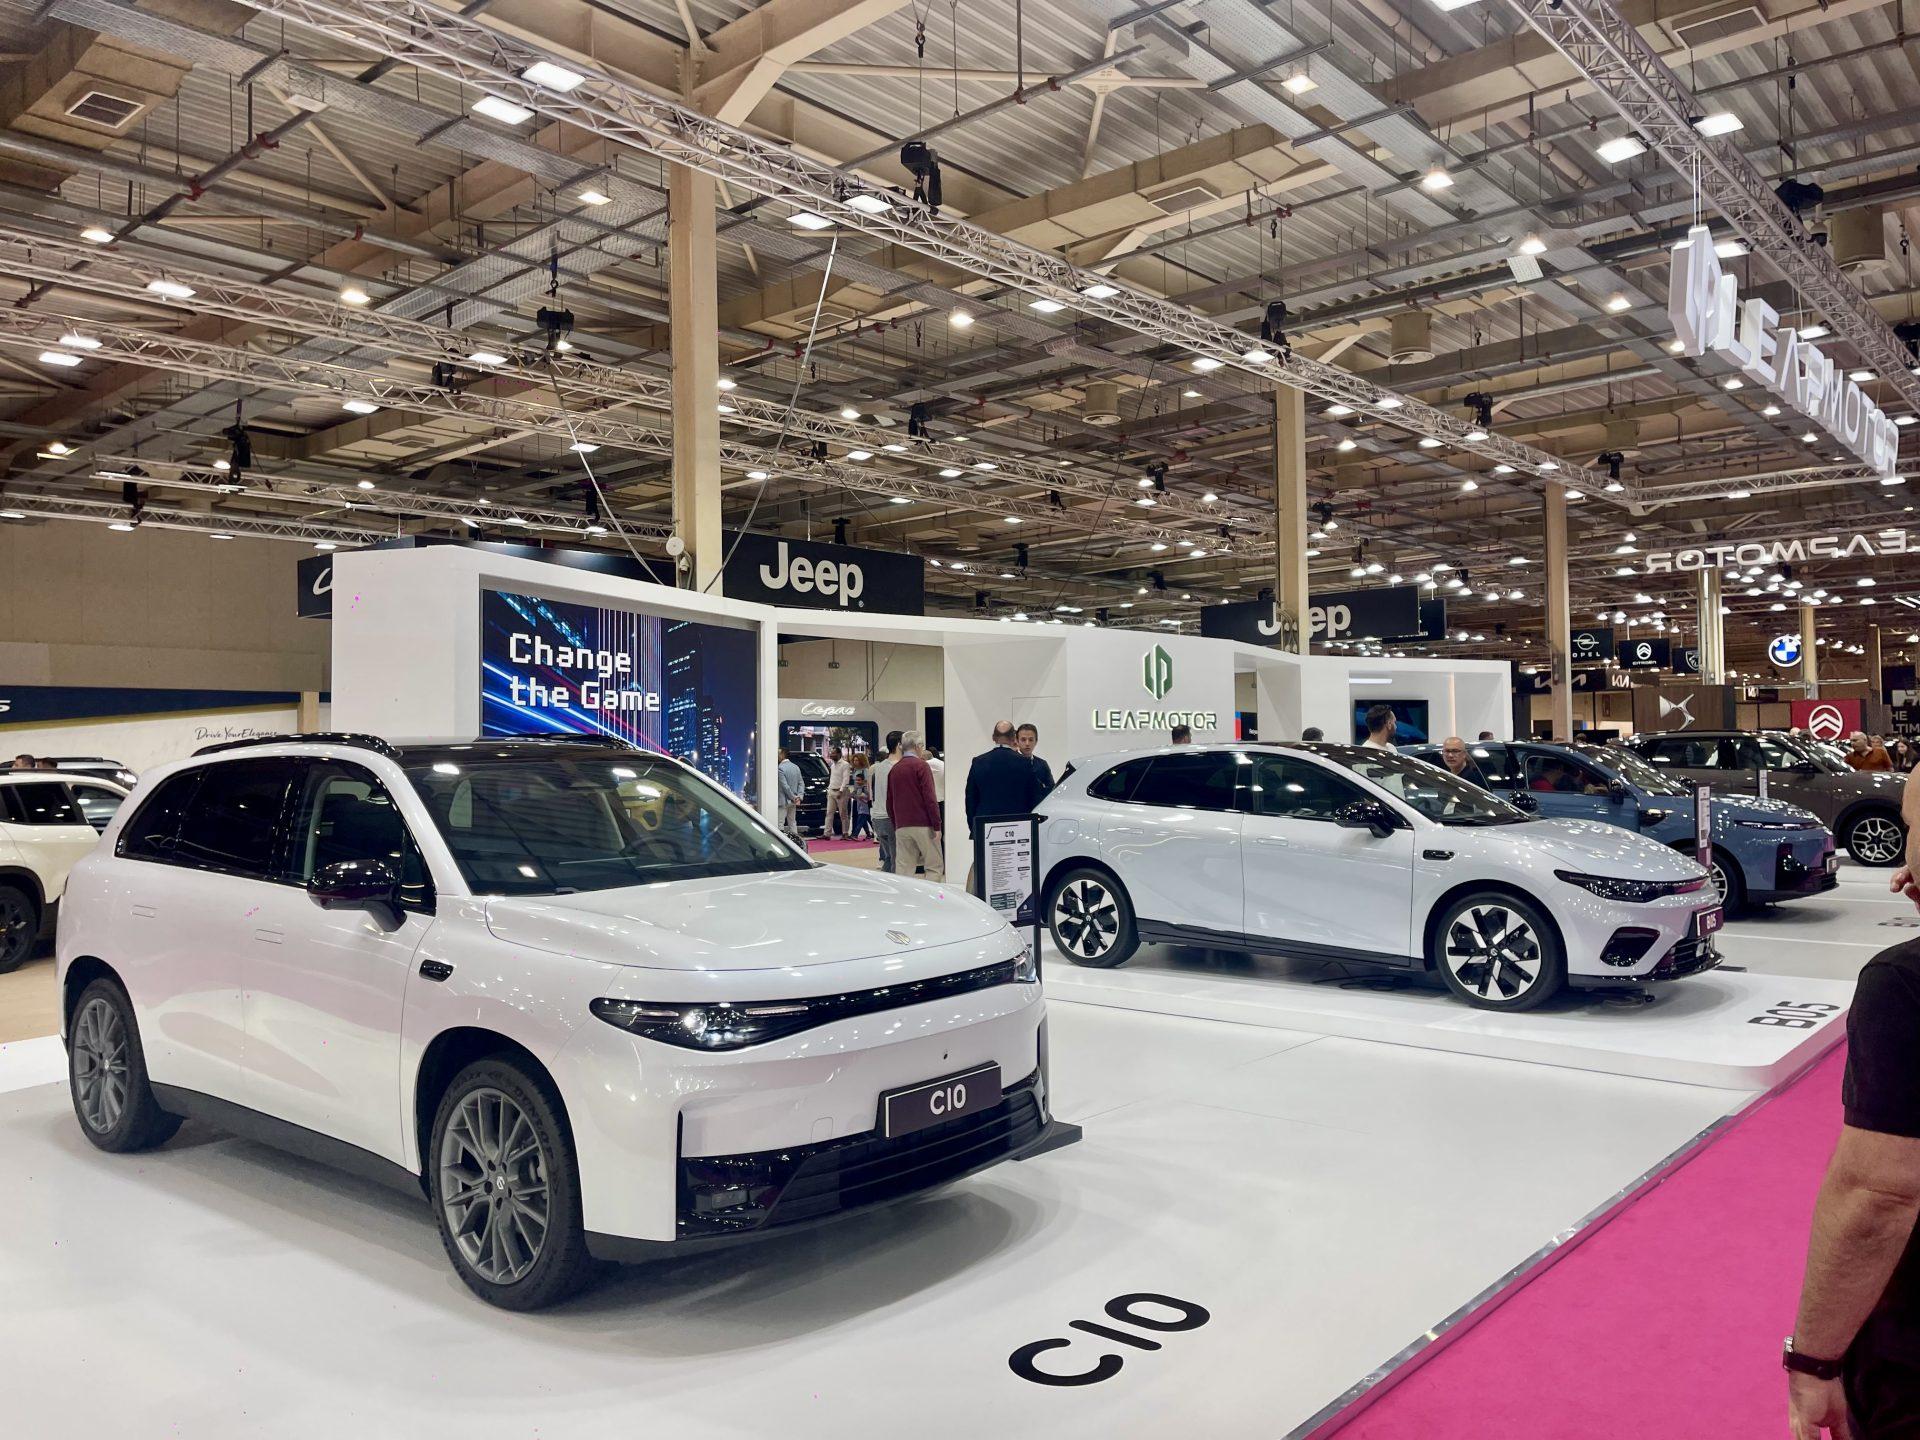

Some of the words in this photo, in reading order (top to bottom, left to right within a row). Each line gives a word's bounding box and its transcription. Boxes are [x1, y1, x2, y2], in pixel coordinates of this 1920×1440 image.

[759, 541, 864, 606] Jeep
[1258, 602, 1351, 638] Jep
[509, 632, 631, 678] Change
[509, 675, 570, 708] the
[581, 681, 661, 712] Game
[195, 727, 221, 740] Drive
[1093, 709, 1217, 730] LEAPMOTOR
[1891, 723, 1920, 734] LTIM
[1004, 830, 1015, 838] C10
[1747, 1001, 1841, 1029] B05
[929, 1083, 967, 1116] C10
[1008, 1293, 1211, 1387] C10
